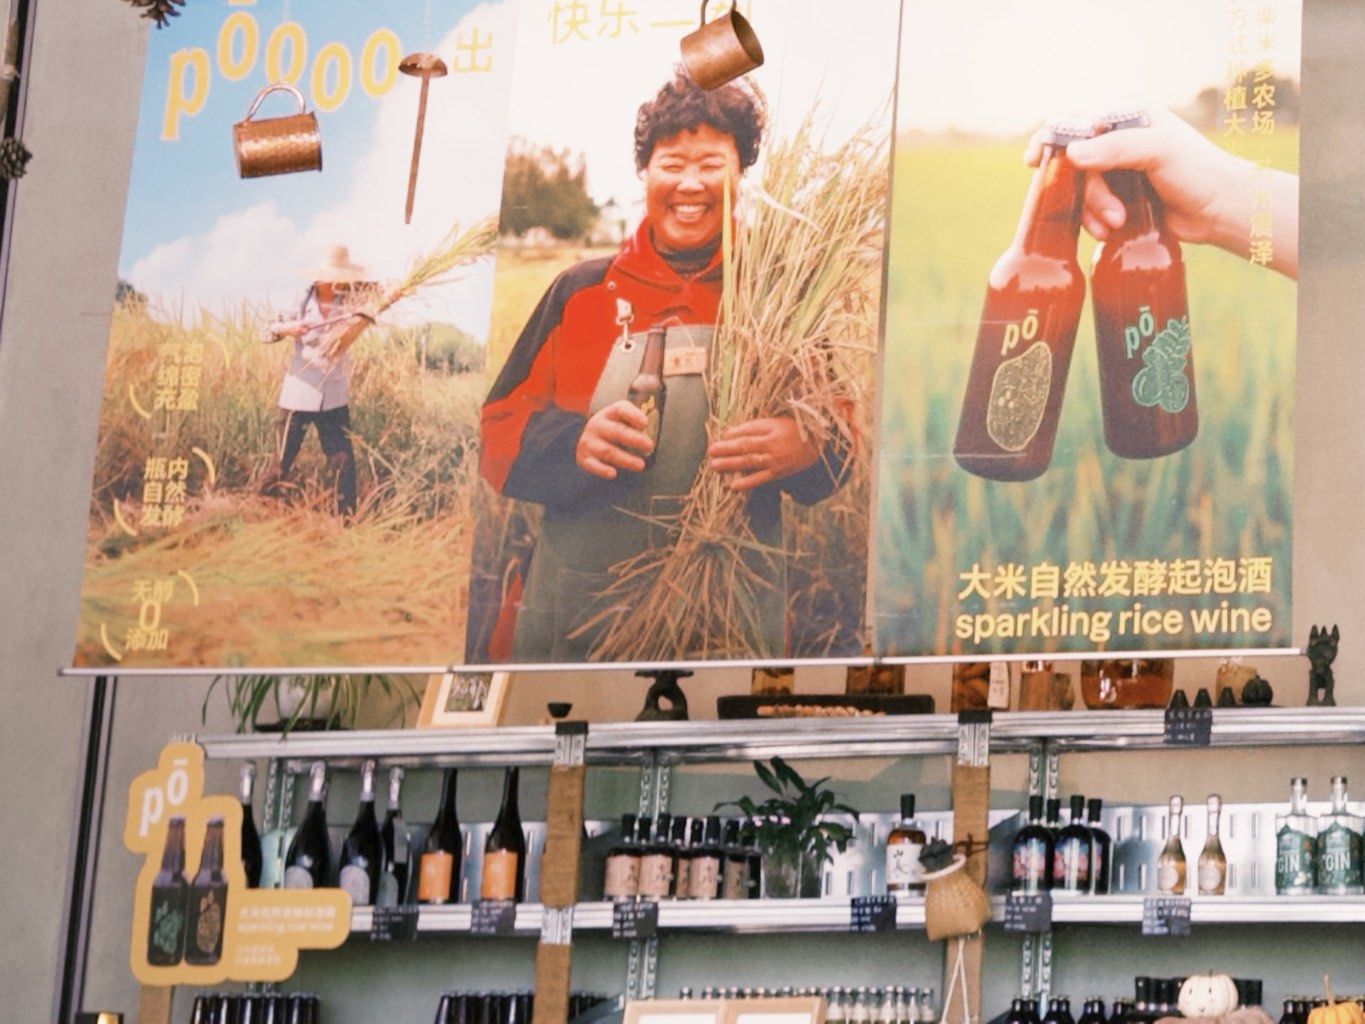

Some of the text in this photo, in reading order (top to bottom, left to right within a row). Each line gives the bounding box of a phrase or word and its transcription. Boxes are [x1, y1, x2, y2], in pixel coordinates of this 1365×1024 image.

[142, 481, 187, 504] 自然
[957, 556, 1273, 600] 大米自然发酵起泡酒
[955, 600, 1273, 644] sparkling rice wine
[1325, 851, 1351, 872] GIN
